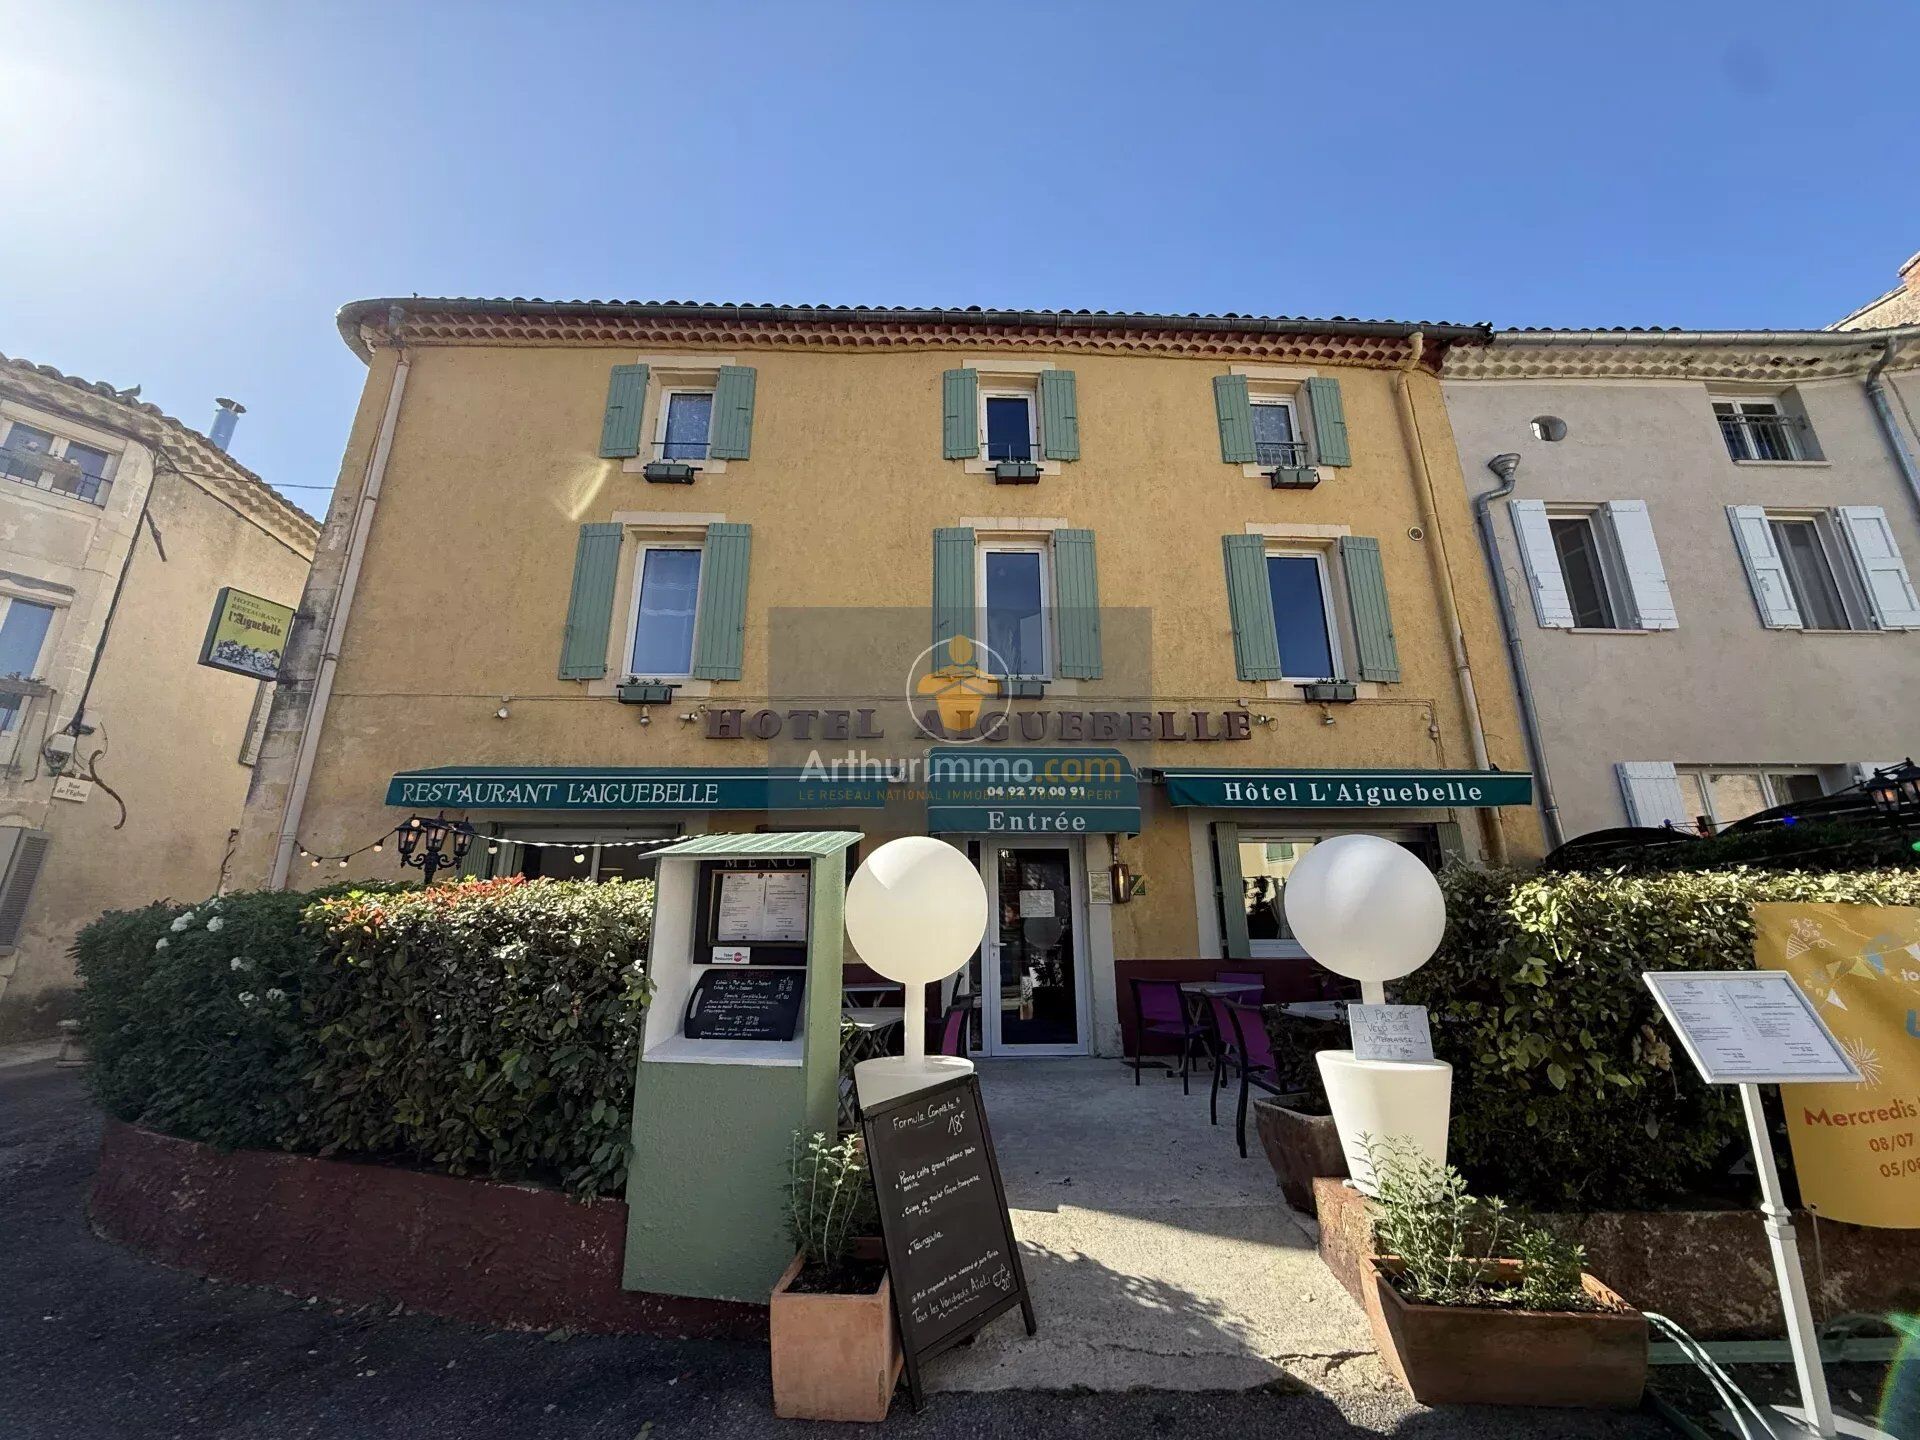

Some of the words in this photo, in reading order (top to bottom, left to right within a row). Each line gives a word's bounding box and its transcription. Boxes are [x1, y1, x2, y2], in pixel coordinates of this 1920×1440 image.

[705, 709, 885, 741] HOTEL
[914, 709, 1252, 742] AIGUEBELLE
[402, 783, 558, 803] RESTAURANT
[566, 783, 719, 804] L'AIGUEBELLE
[987, 786, 1004, 797] 04
[1008, 786, 1025, 796] 92
[1029, 786, 1046, 796] 79
[1049, 786, 1067, 796] 00
[1070, 786, 1085, 796] 91
[1223, 782, 1298, 801] Hôtel
[1310, 782, 1483, 806] L'Aiguebelle
[987, 811, 1086, 831] Entrée
[724, 859, 797, 868] MENU
[1803, 1098, 1918, 1127] Mercredis
[1869, 1132, 1913, 1153] 08/07
